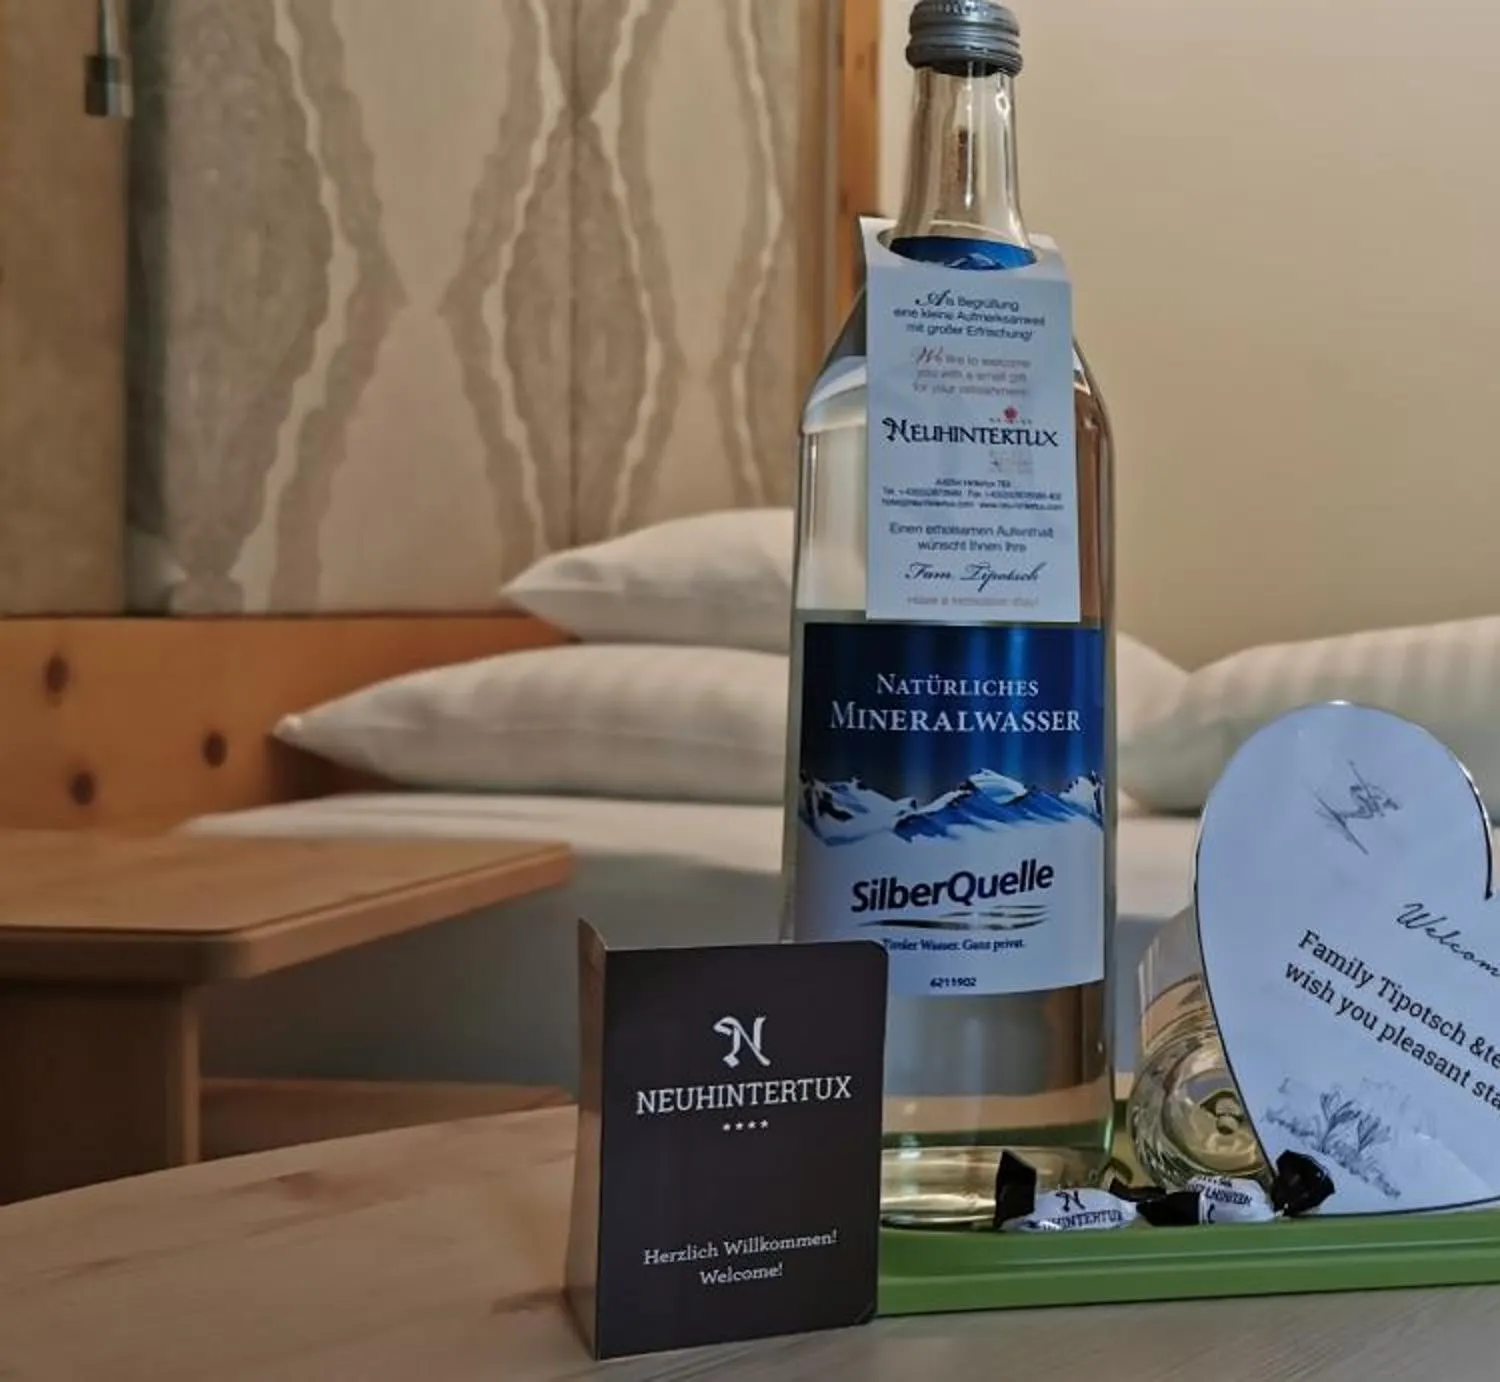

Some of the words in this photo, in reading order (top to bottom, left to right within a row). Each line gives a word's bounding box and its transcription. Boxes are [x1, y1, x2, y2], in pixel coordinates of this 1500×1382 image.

[893, 307, 918, 318] eine
[920, 308, 953, 320] kleine
[906, 322, 924, 333] mit
[881, 416, 1060, 447] NEUHINTERTUX
[889, 522, 923, 534] Einen
[876, 672, 1039, 697] NATÜRLICHES
[830, 700, 1081, 733] MINERALWASSER
[851, 858, 1054, 913] SilberQuelle
[962, 939, 991, 951] Ganz
[1298, 929, 1375, 989] Family
[1377, 976, 1467, 1046] Tipotsch
[1285, 962, 1335, 1004] wish
[1335, 996, 1378, 1031] you
[1376, 1022, 1472, 1088] pleasant
[635, 1075, 853, 1115] NEUHINTERTUX
[643, 1241, 719, 1266] Herzlich
[723, 1229, 838, 1256] Willkommen!
[700, 1263, 784, 1286] Welcome!
